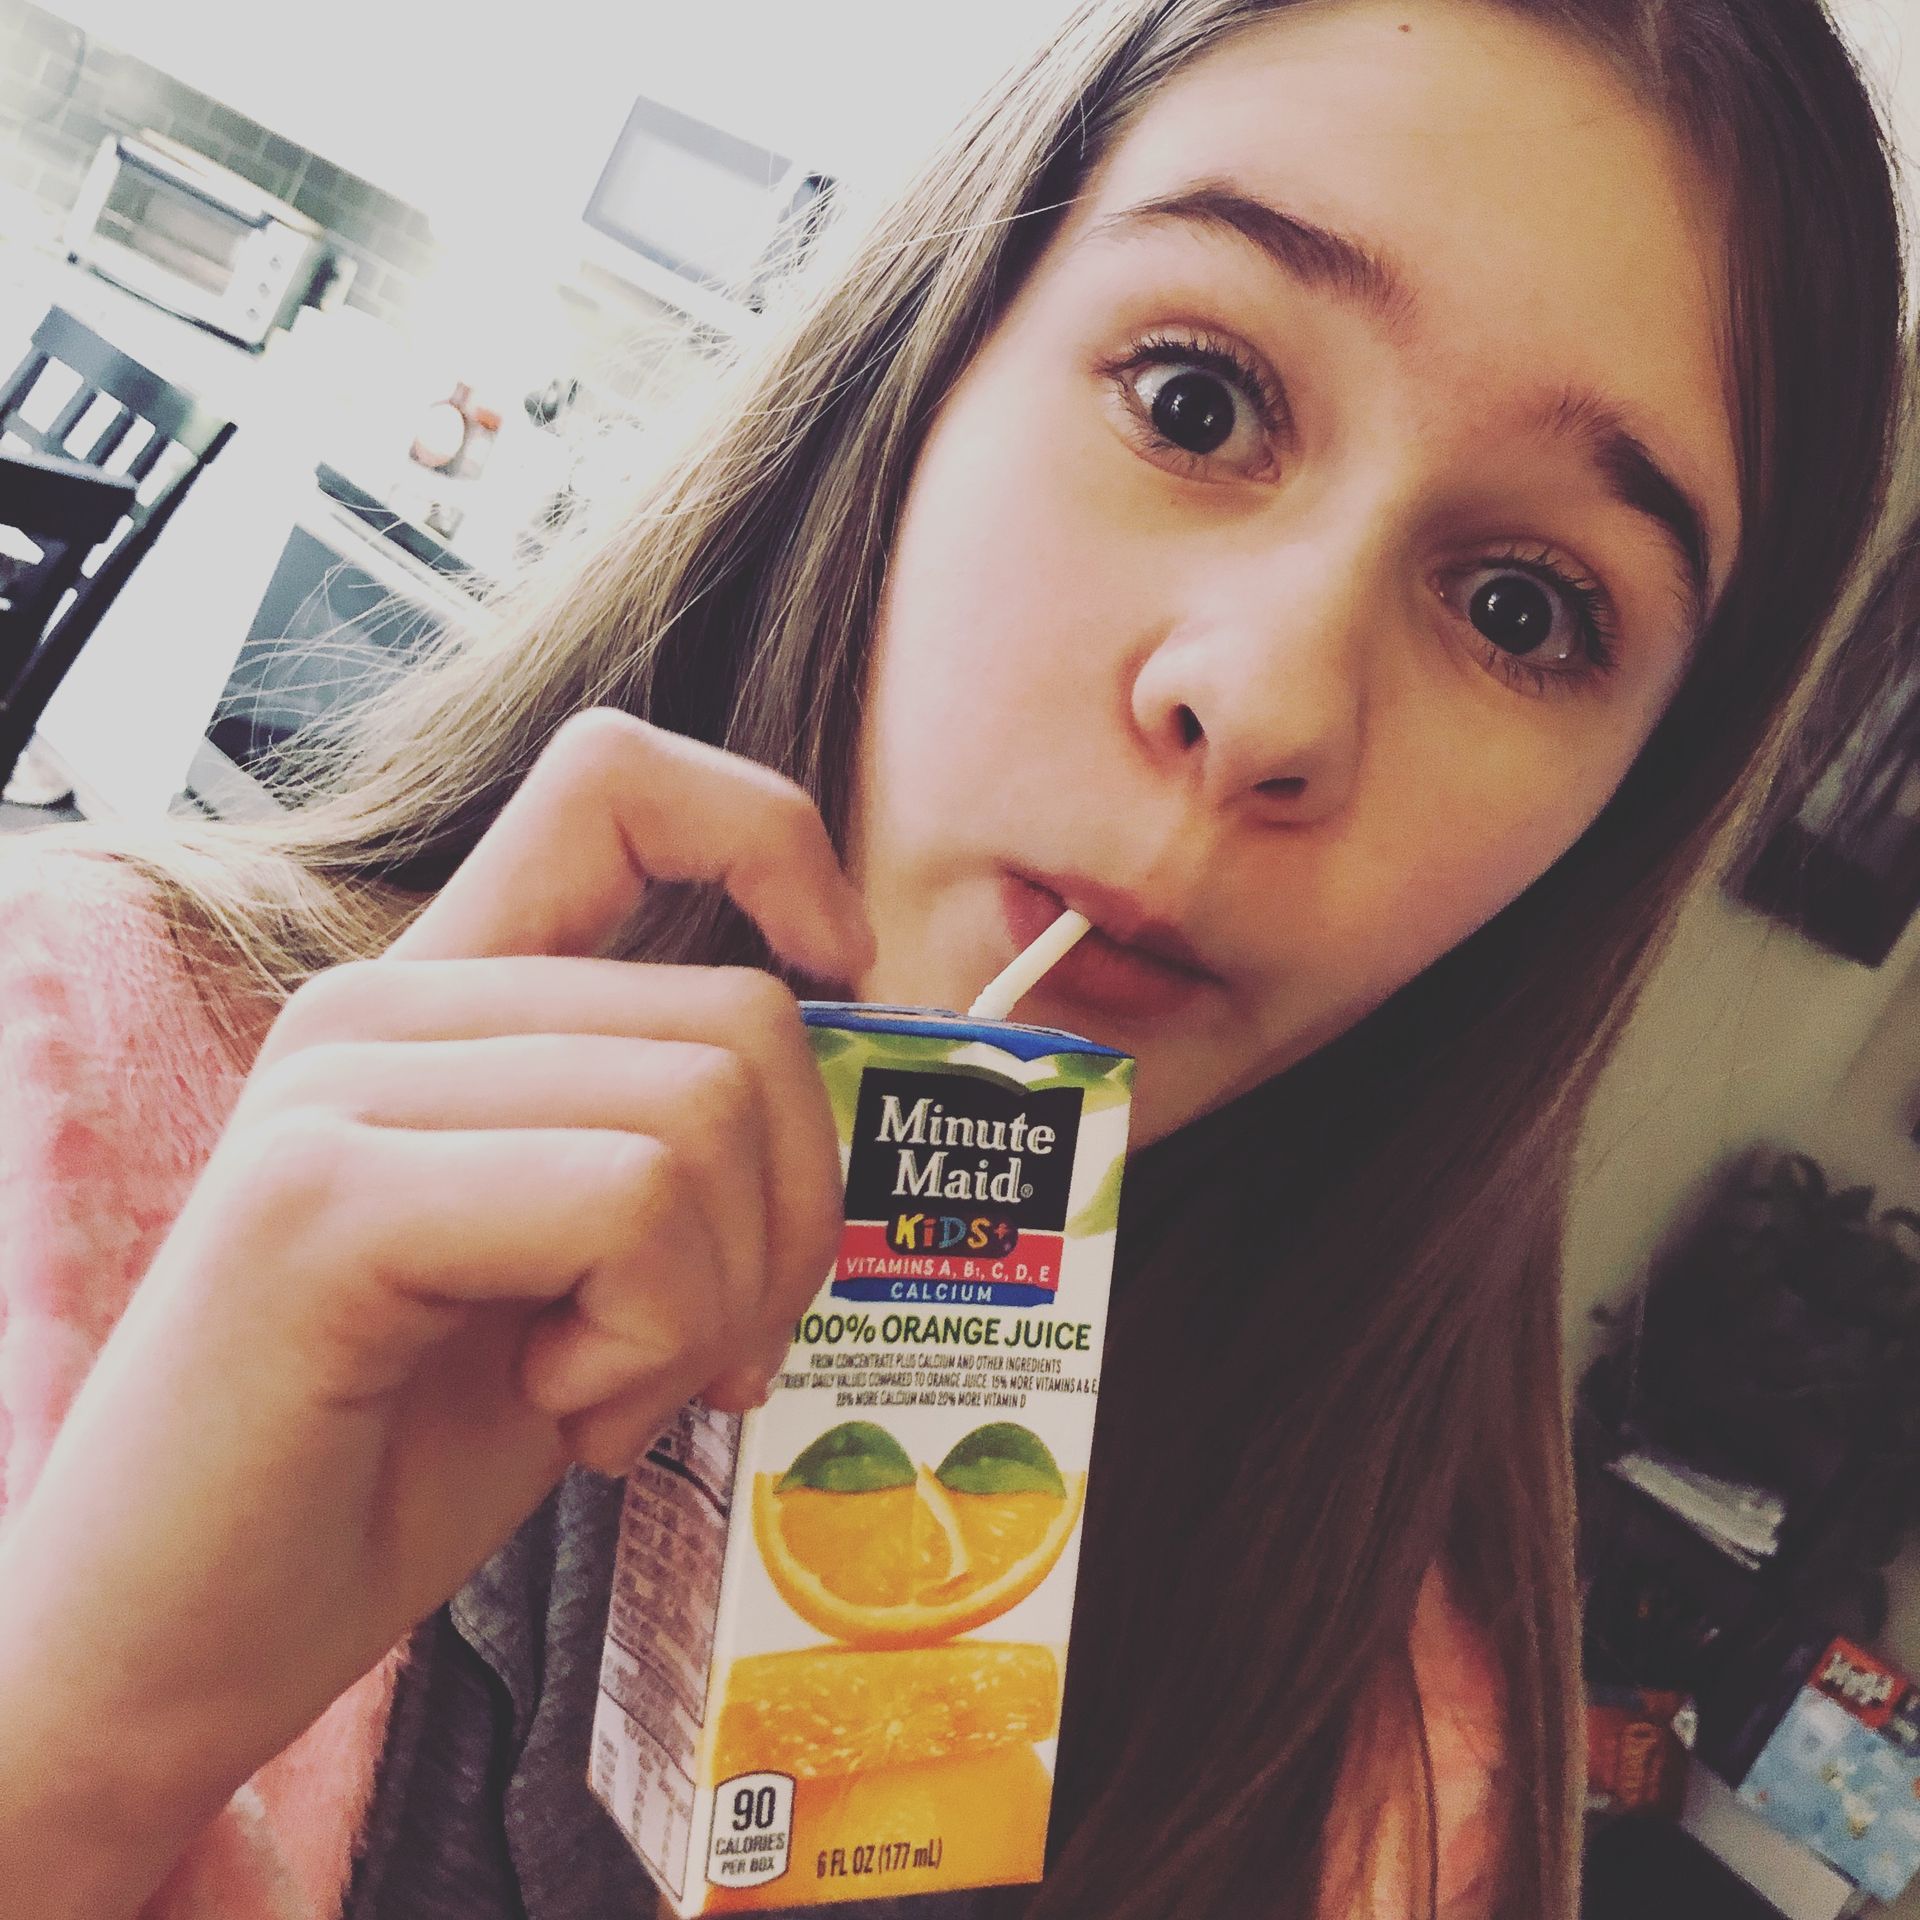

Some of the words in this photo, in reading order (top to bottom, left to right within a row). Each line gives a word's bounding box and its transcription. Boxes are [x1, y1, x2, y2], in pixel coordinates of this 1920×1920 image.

[875, 1095, 1056, 1154] Minute
[847, 1257, 934, 1277] VITAMINS
[939, 1259, 957, 1278] A,
[992, 1264, 1009, 1282] C,
[1039, 1265, 1051, 1282] E
[891, 1281, 993, 1302] CALCIUM
[882, 1314, 1001, 1346] ORANGE
[1004, 1319, 1092, 1350] JUICE
[835, 1353, 894, 1369] CONCENTRATE
[896, 1353, 916, 1368] PLUS
[918, 1353, 956, 1369] CALCIUM
[957, 1355, 974, 1369] AND
[976, 1355, 1004, 1371] OTHER
[1005, 1356, 1062, 1373] INGREDIENTS
[868, 1371, 913, 1387] COMPARED
[915, 1371, 926, 1387] TO
[927, 1372, 961, 1388] ORANGE
[1010, 1375, 1033, 1391] MORE
[1035, 1376, 1075, 1393] VITAMINS
[1076, 1378, 1083, 1393] A
[1083, 1379, 1090, 1393] &
[855, 1391, 879, 1406] MORE
[880, 1390, 918, 1406] CALCIUM
[919, 1391, 936, 1406] AND
[957, 1391, 981, 1407] MORE
[983, 1392, 1018, 1408] VITAMIN
[1019, 1394, 1027, 1408] D
[731, 1786, 777, 1831] 90
[715, 1832, 786, 1855] CALORIES
[721, 1859, 746, 1875] PER
[749, 1856, 774, 1873] BOX
[816, 1850, 826, 1879] 6
[829, 1848, 848, 1877] FL
[852, 1845, 875, 1875] OZ
[878, 1841, 911, 1875] (177
[912, 1836, 943, 1870] mL)
